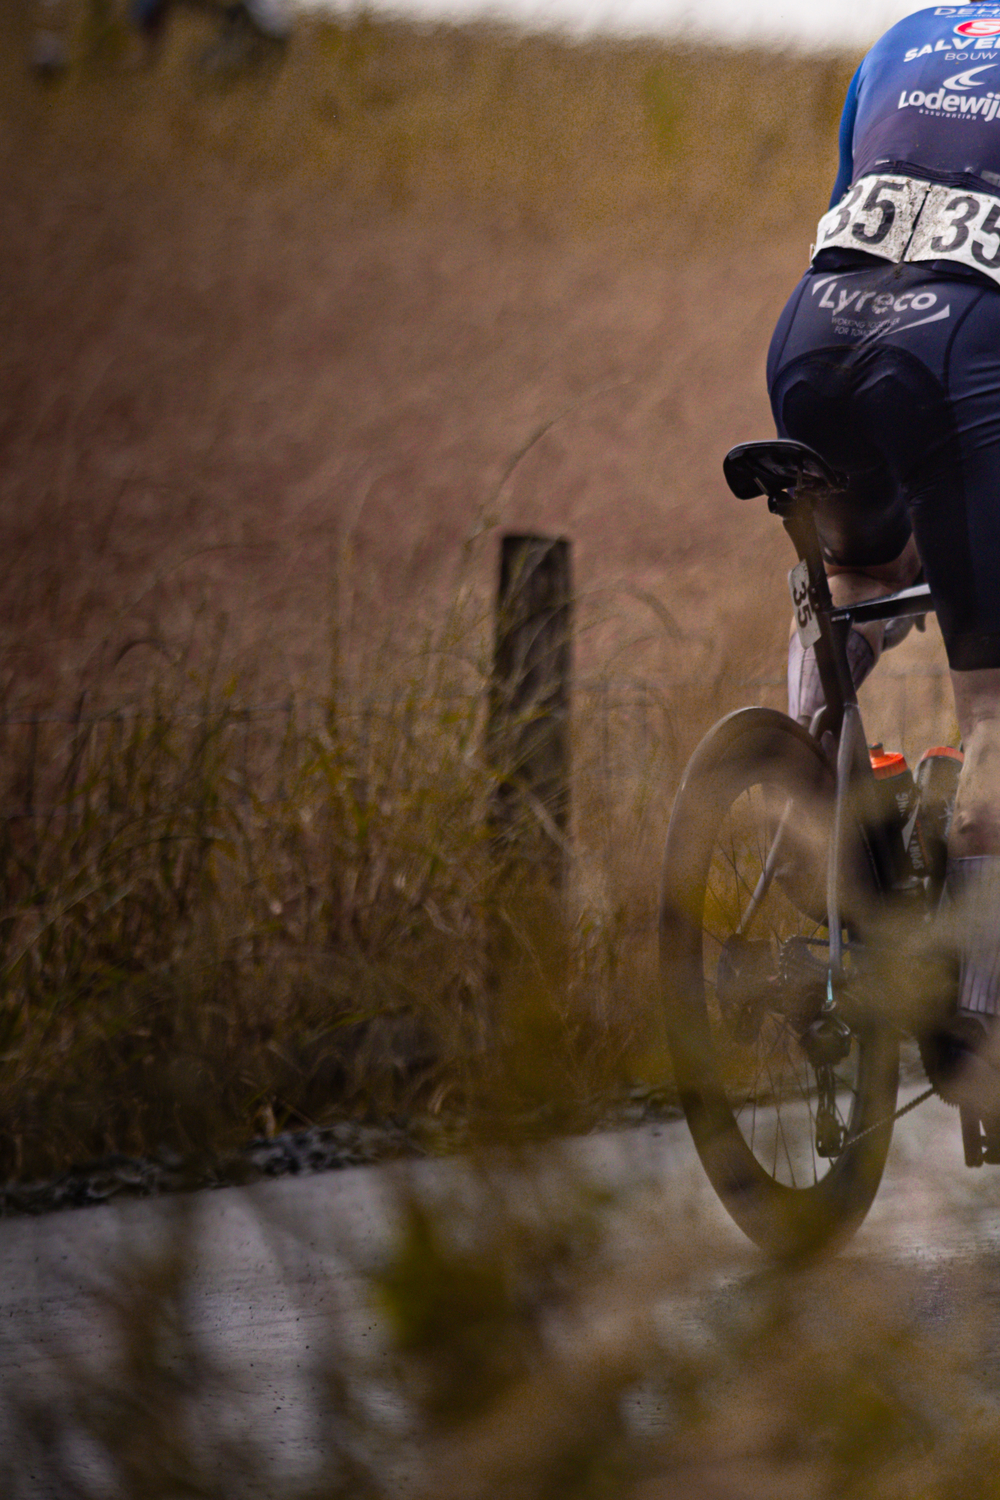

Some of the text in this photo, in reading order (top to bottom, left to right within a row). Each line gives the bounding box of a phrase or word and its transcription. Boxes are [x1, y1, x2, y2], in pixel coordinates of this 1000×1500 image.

[944, 52, 998, 61] BOUW
[818, 282, 938, 317] Lyreco
[793, 581, 813, 629] 35
